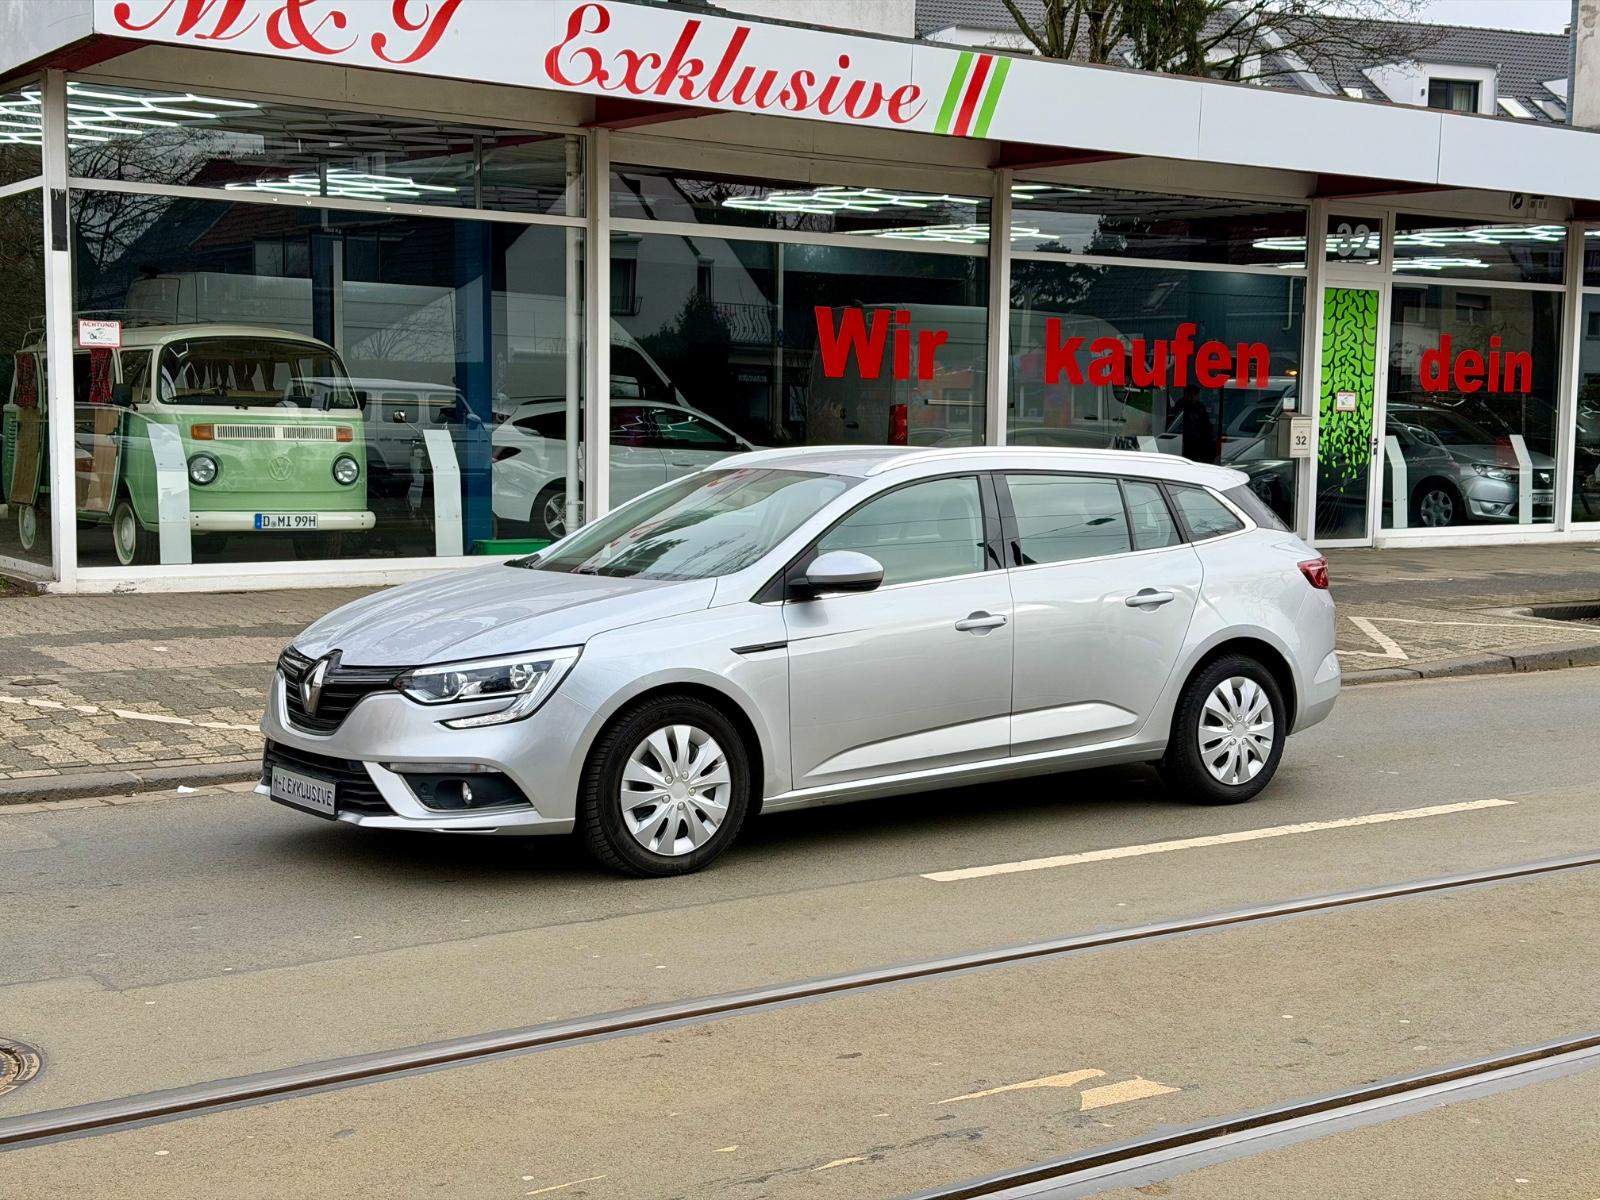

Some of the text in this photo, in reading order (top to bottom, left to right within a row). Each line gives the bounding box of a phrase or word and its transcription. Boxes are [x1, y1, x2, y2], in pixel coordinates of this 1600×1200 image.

[544, 3, 928, 124] Exklusive
[1336, 222, 1371, 257] 32
[814, 305, 1534, 393] Wir kaufen dein
[1295, 435, 1307, 446] 32
[294, 515, 316, 527] 99H
